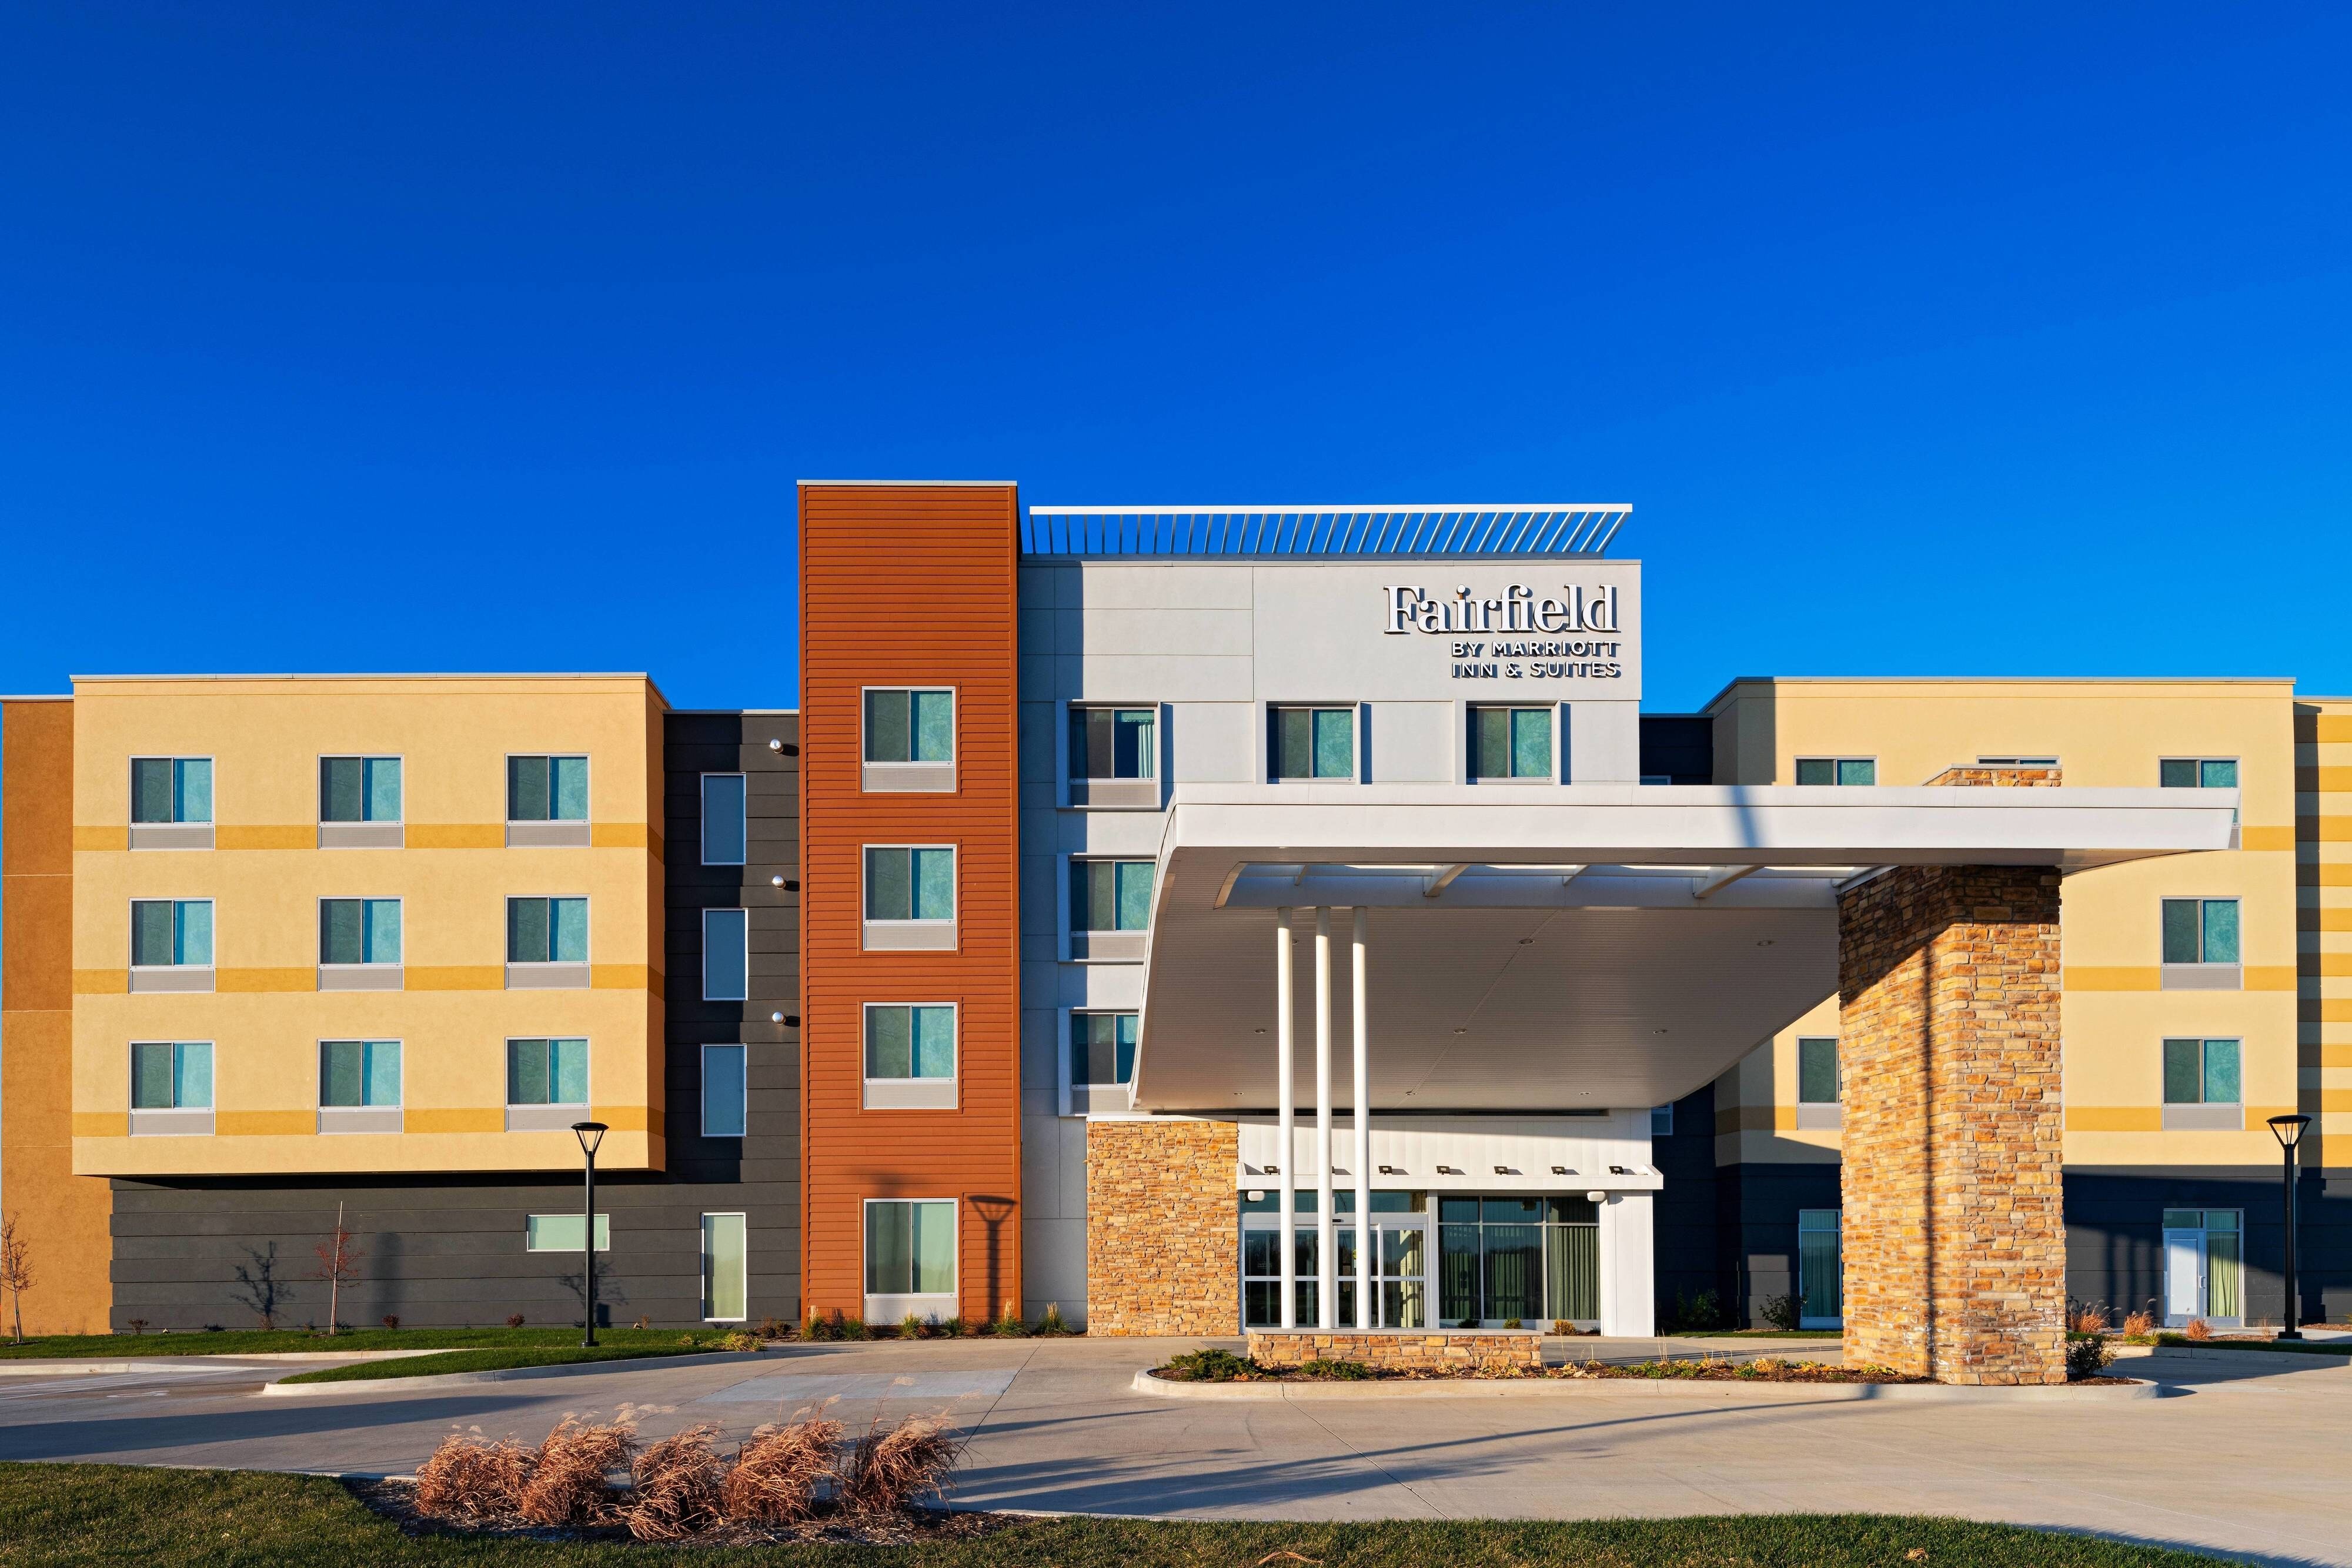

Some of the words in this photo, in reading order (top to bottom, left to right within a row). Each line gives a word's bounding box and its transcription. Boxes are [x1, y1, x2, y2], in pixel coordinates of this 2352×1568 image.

[1384, 583, 1618, 633] Fairfield
[1452, 641, 1481, 656] BY
[1492, 640, 1617, 656] MARRIOTT
[1452, 662, 1494, 677] INN
[1505, 661, 1519, 677] &
[1530, 661, 1618, 677] SUITES
